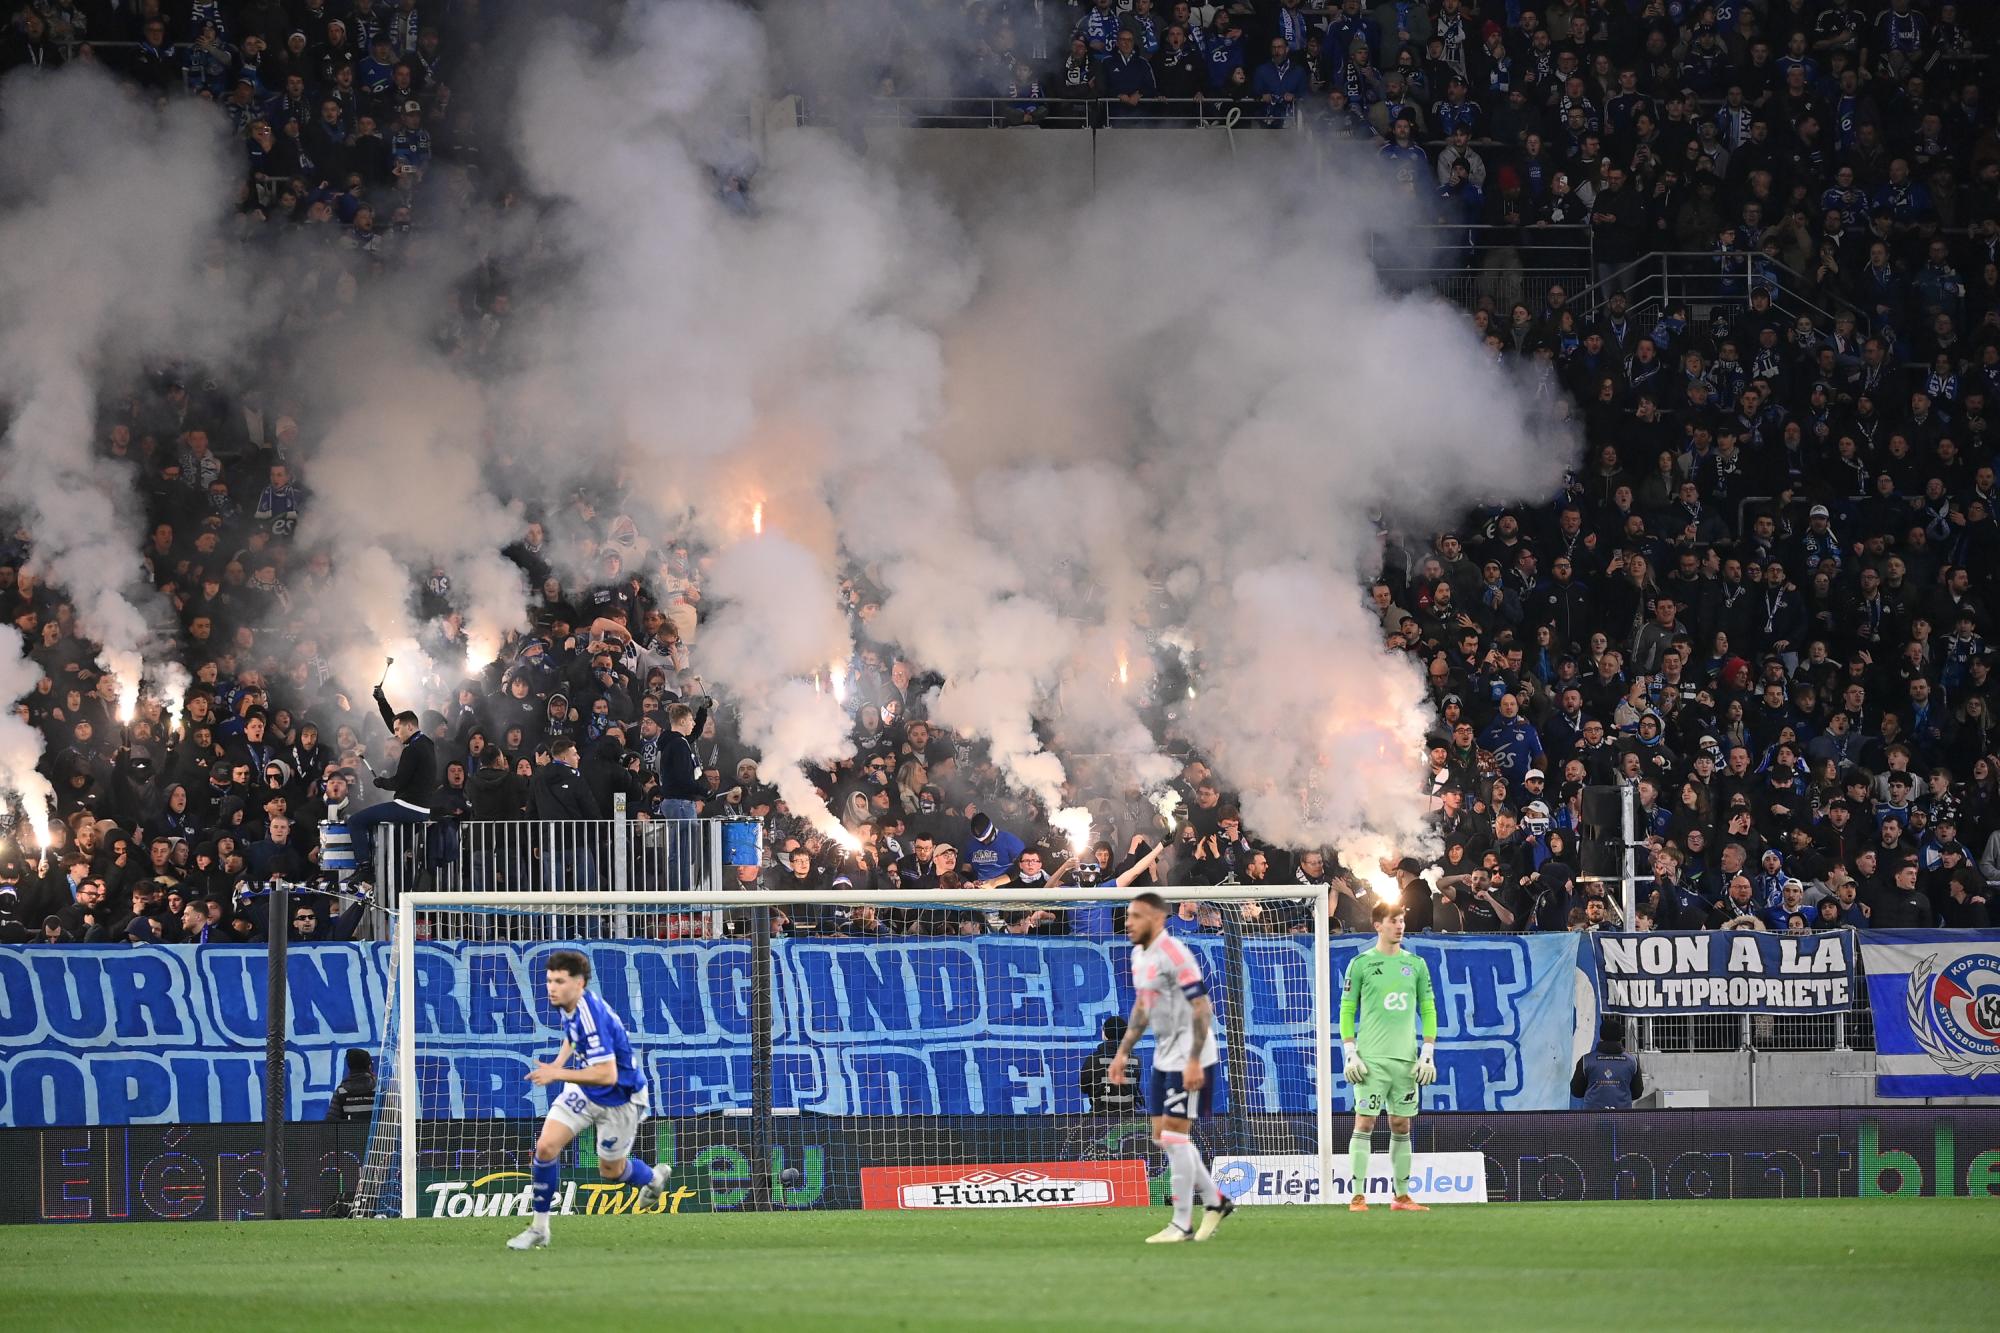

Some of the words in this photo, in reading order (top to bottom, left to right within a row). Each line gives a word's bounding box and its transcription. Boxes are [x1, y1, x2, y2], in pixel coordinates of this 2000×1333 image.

[1600, 935, 1710, 974] NON
[1728, 936, 1764, 973] A
[1780, 937, 1847, 973] LA
[1951, 959, 1974, 976] KOP
[1978, 958, 2000, 972] CIE
[209, 952, 360, 1038] UN
[1606, 976, 1849, 1008] MULTIPROPRIETE
[1939, 1006, 2000, 1053] STRASBOURG
[565, 1091, 587, 1114] 29
[1368, 1093, 1381, 1111] 39
[931, 1183, 1076, 1206] Hünkar
